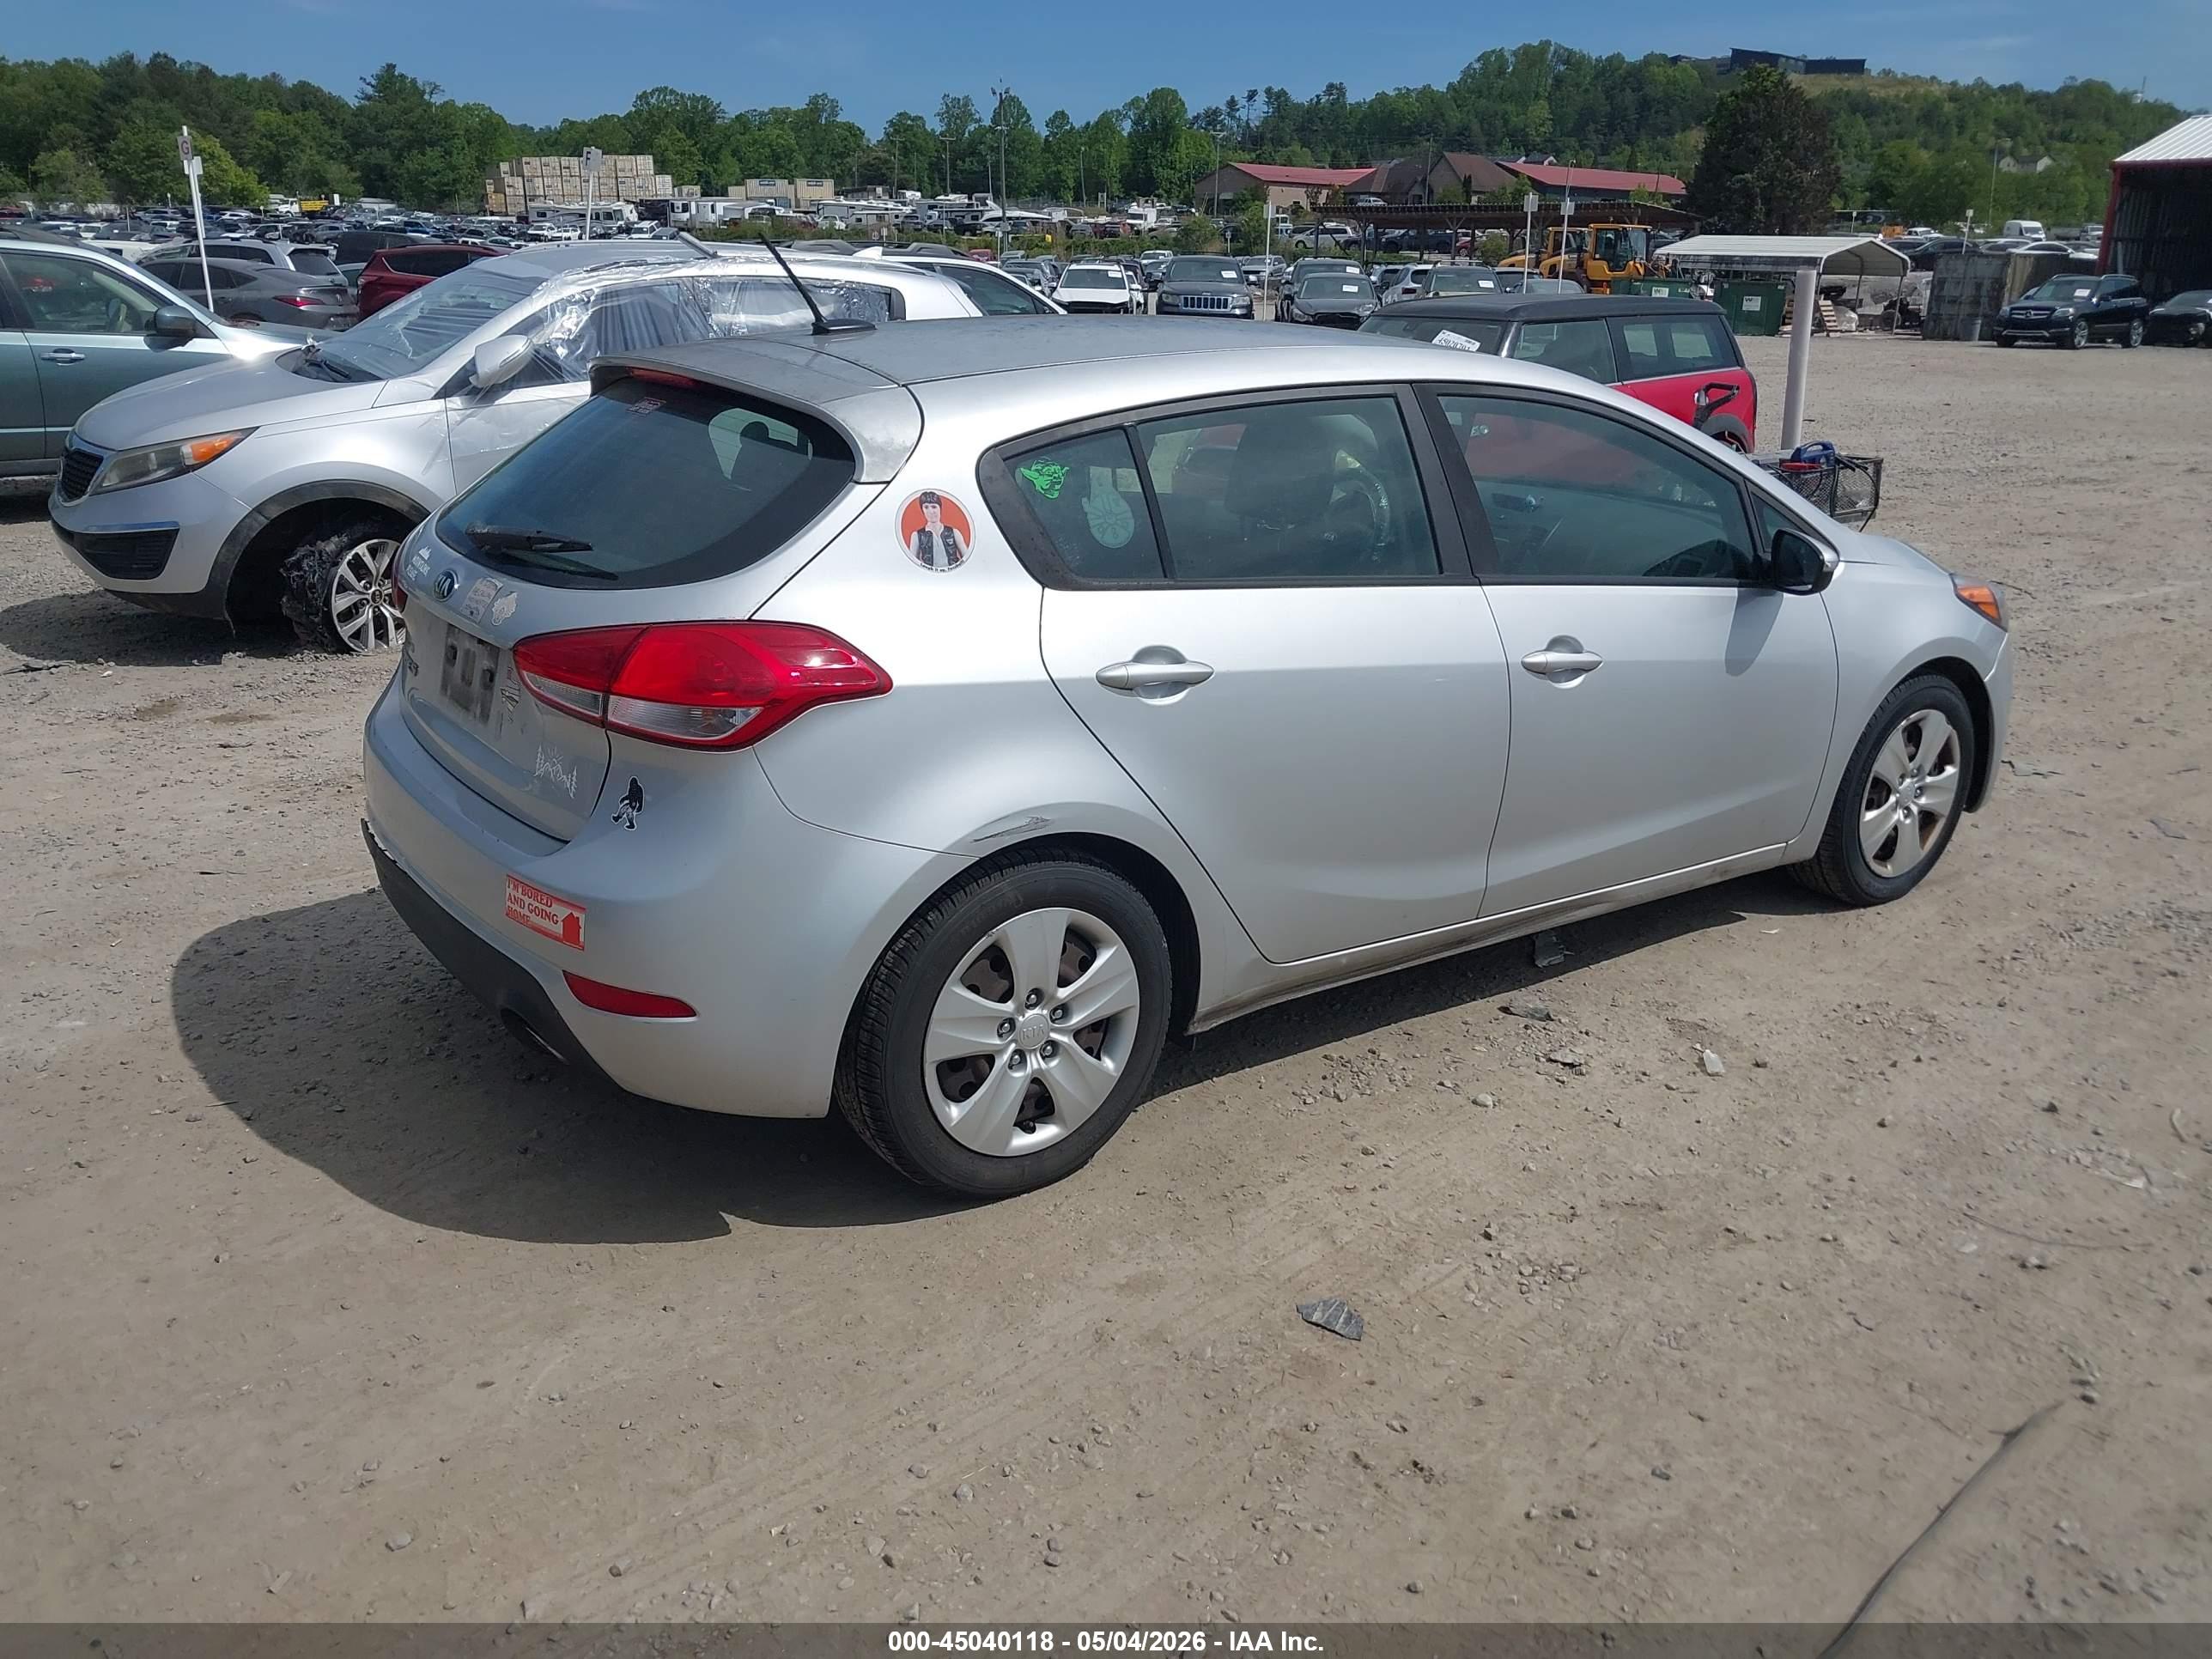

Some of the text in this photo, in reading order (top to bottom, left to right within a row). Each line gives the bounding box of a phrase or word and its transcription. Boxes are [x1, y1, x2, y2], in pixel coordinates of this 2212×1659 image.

[181, 140, 190, 155] G
[586, 151, 592, 166] F
[521, 884, 553, 908] BORED
[507, 892, 559, 926] AND GOING
[507, 905, 531, 925] HOME
[1022, 1024, 1045, 1040] KIA
